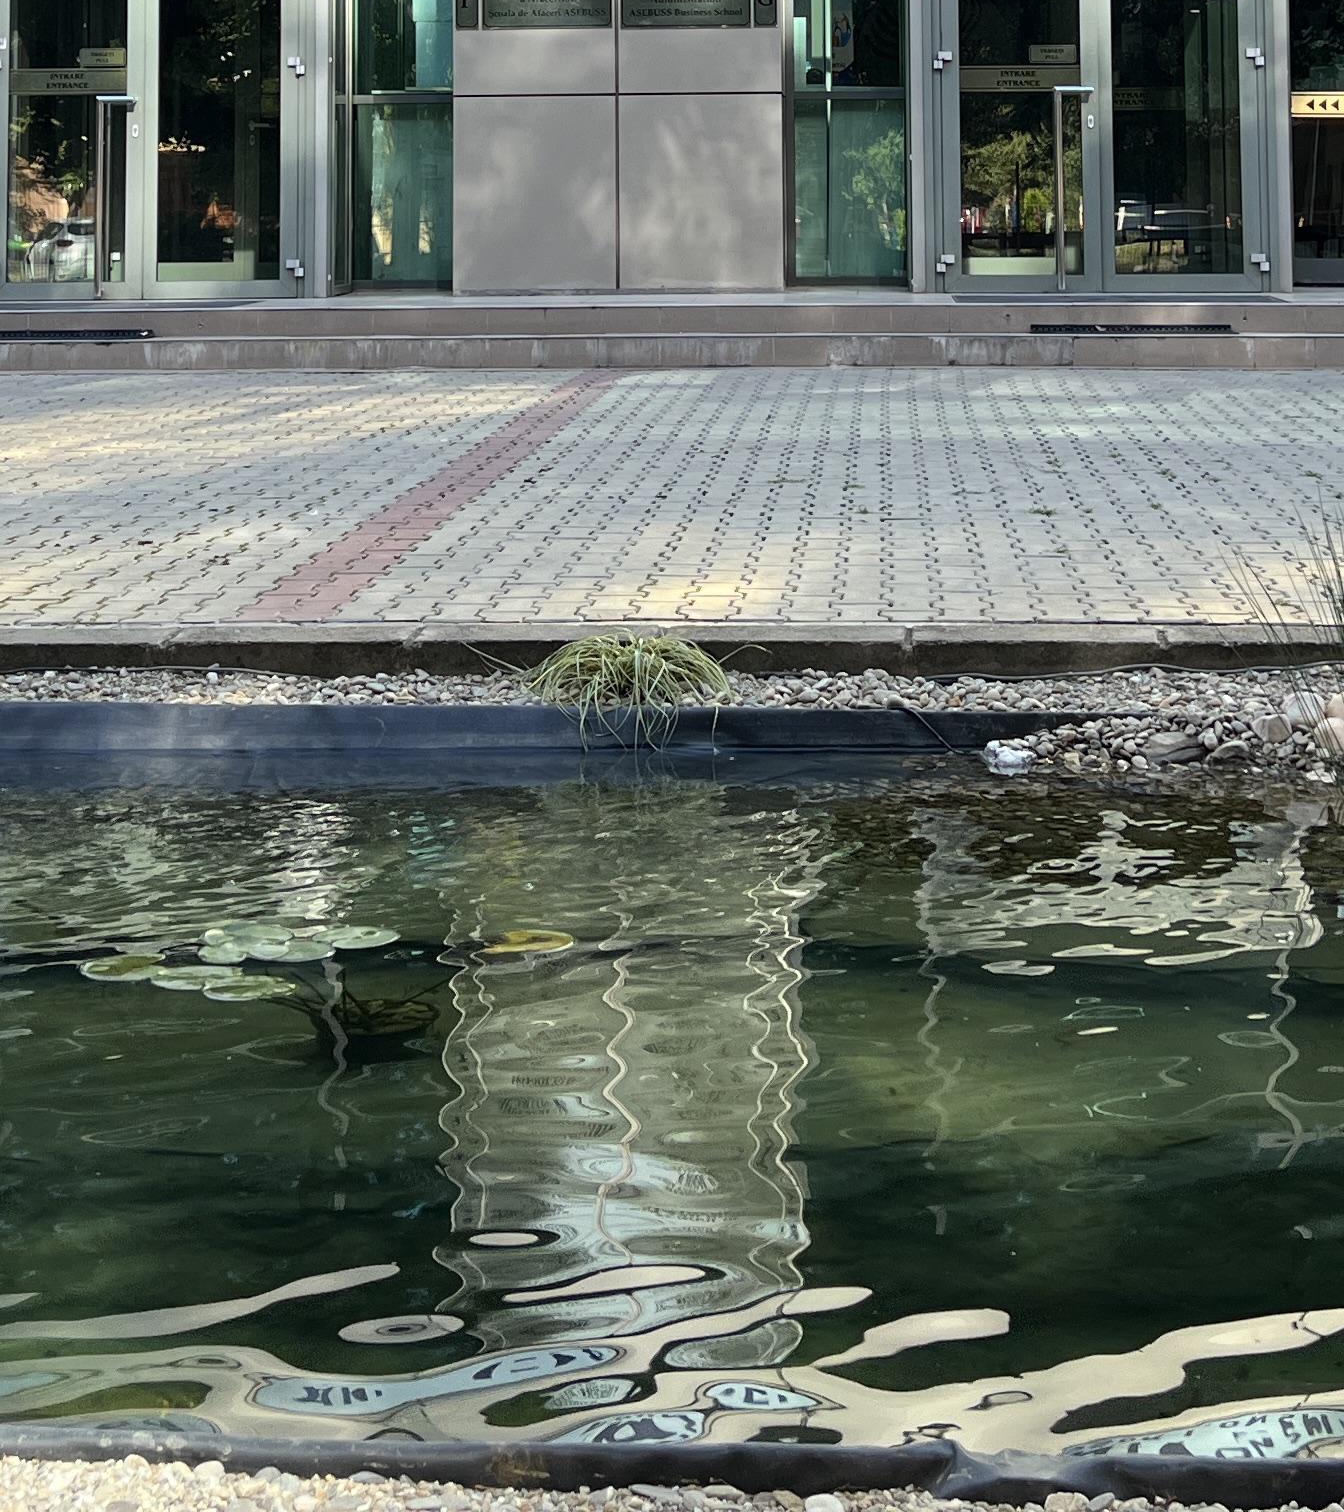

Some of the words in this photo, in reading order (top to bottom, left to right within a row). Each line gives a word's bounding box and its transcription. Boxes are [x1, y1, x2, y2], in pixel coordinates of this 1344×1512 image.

[518, 9, 528, 17] de
[564, 8, 606, 17] ASEBUSS
[629, 9, 672, 17] ASEBUSS
[714, 8, 743, 16] School
[996, 79, 1040, 87] ENTRANCE
